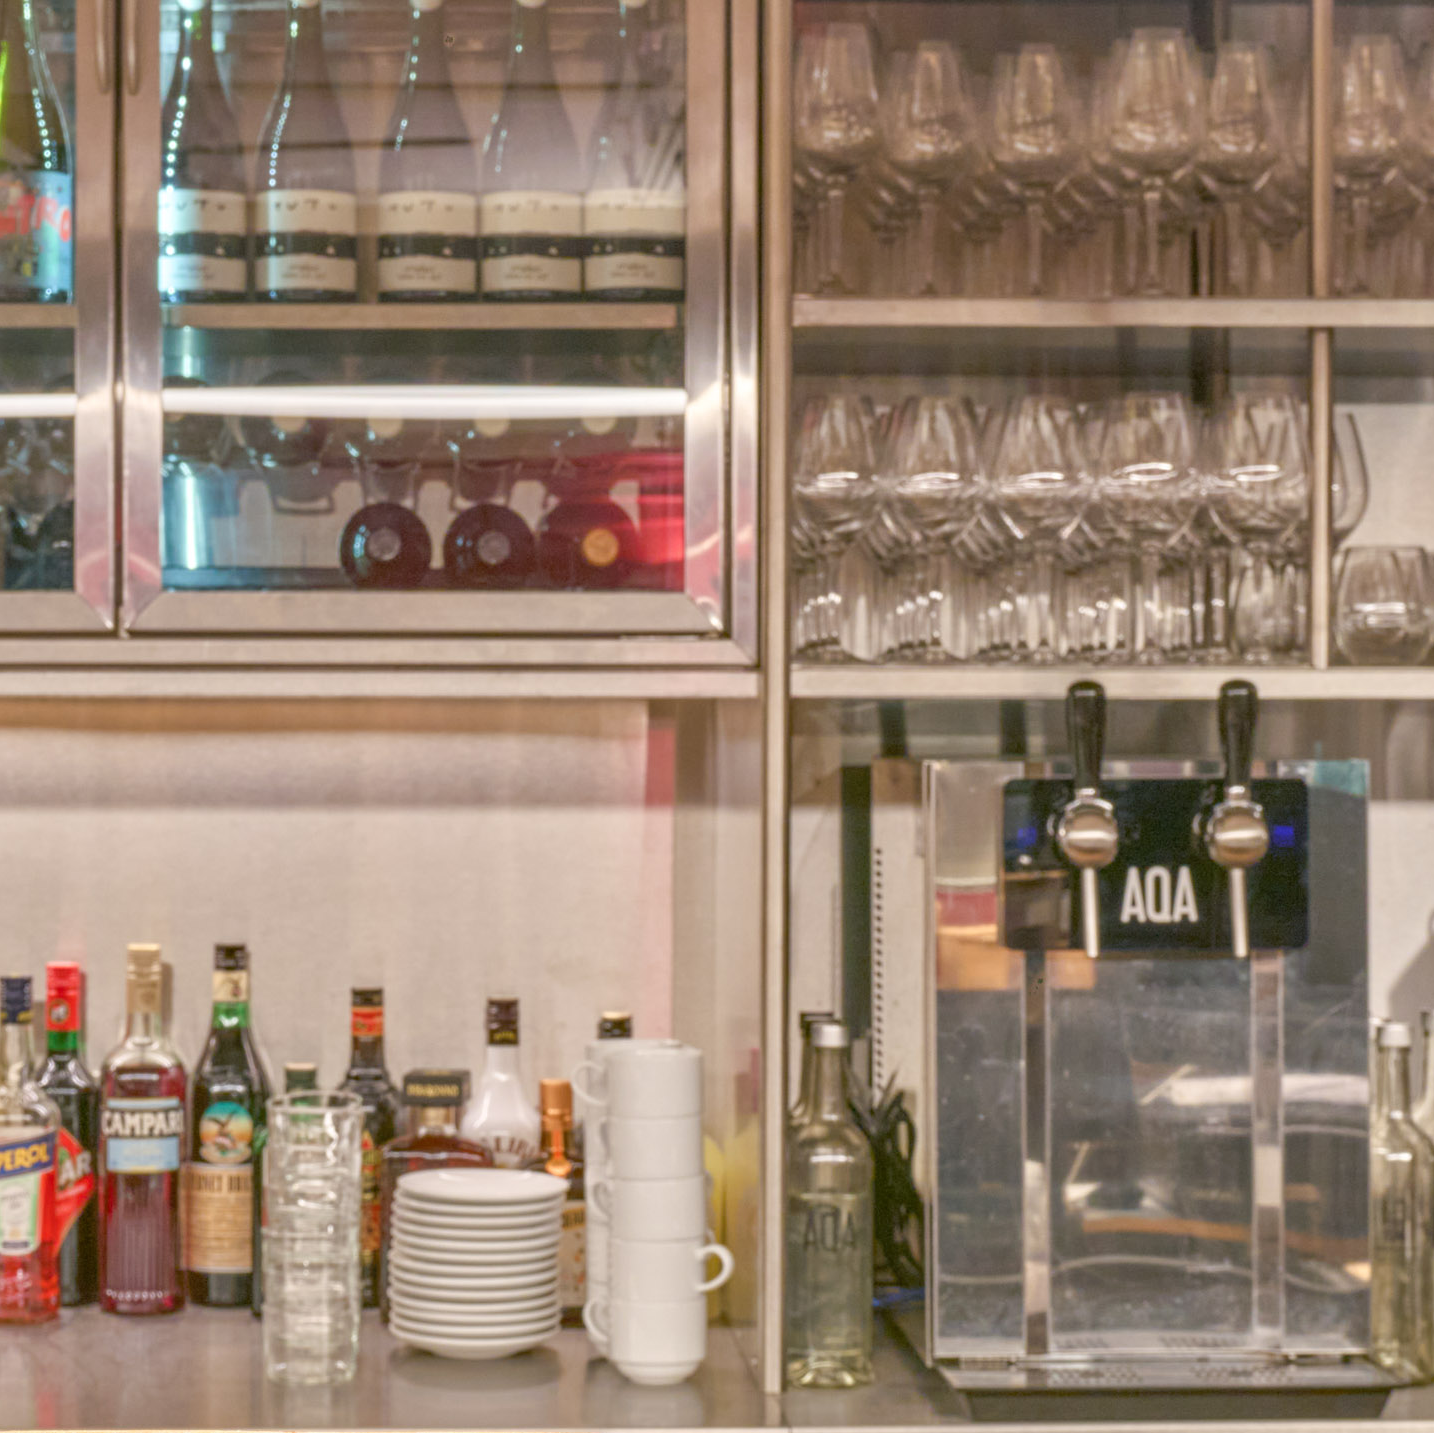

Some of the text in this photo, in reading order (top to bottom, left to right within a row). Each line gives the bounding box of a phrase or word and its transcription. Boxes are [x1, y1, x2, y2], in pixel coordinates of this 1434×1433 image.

[1120, 865, 1199, 923] AQA
[101, 1109, 184, 1136] CAMPARI
[803, 1203, 856, 1252] AQA
